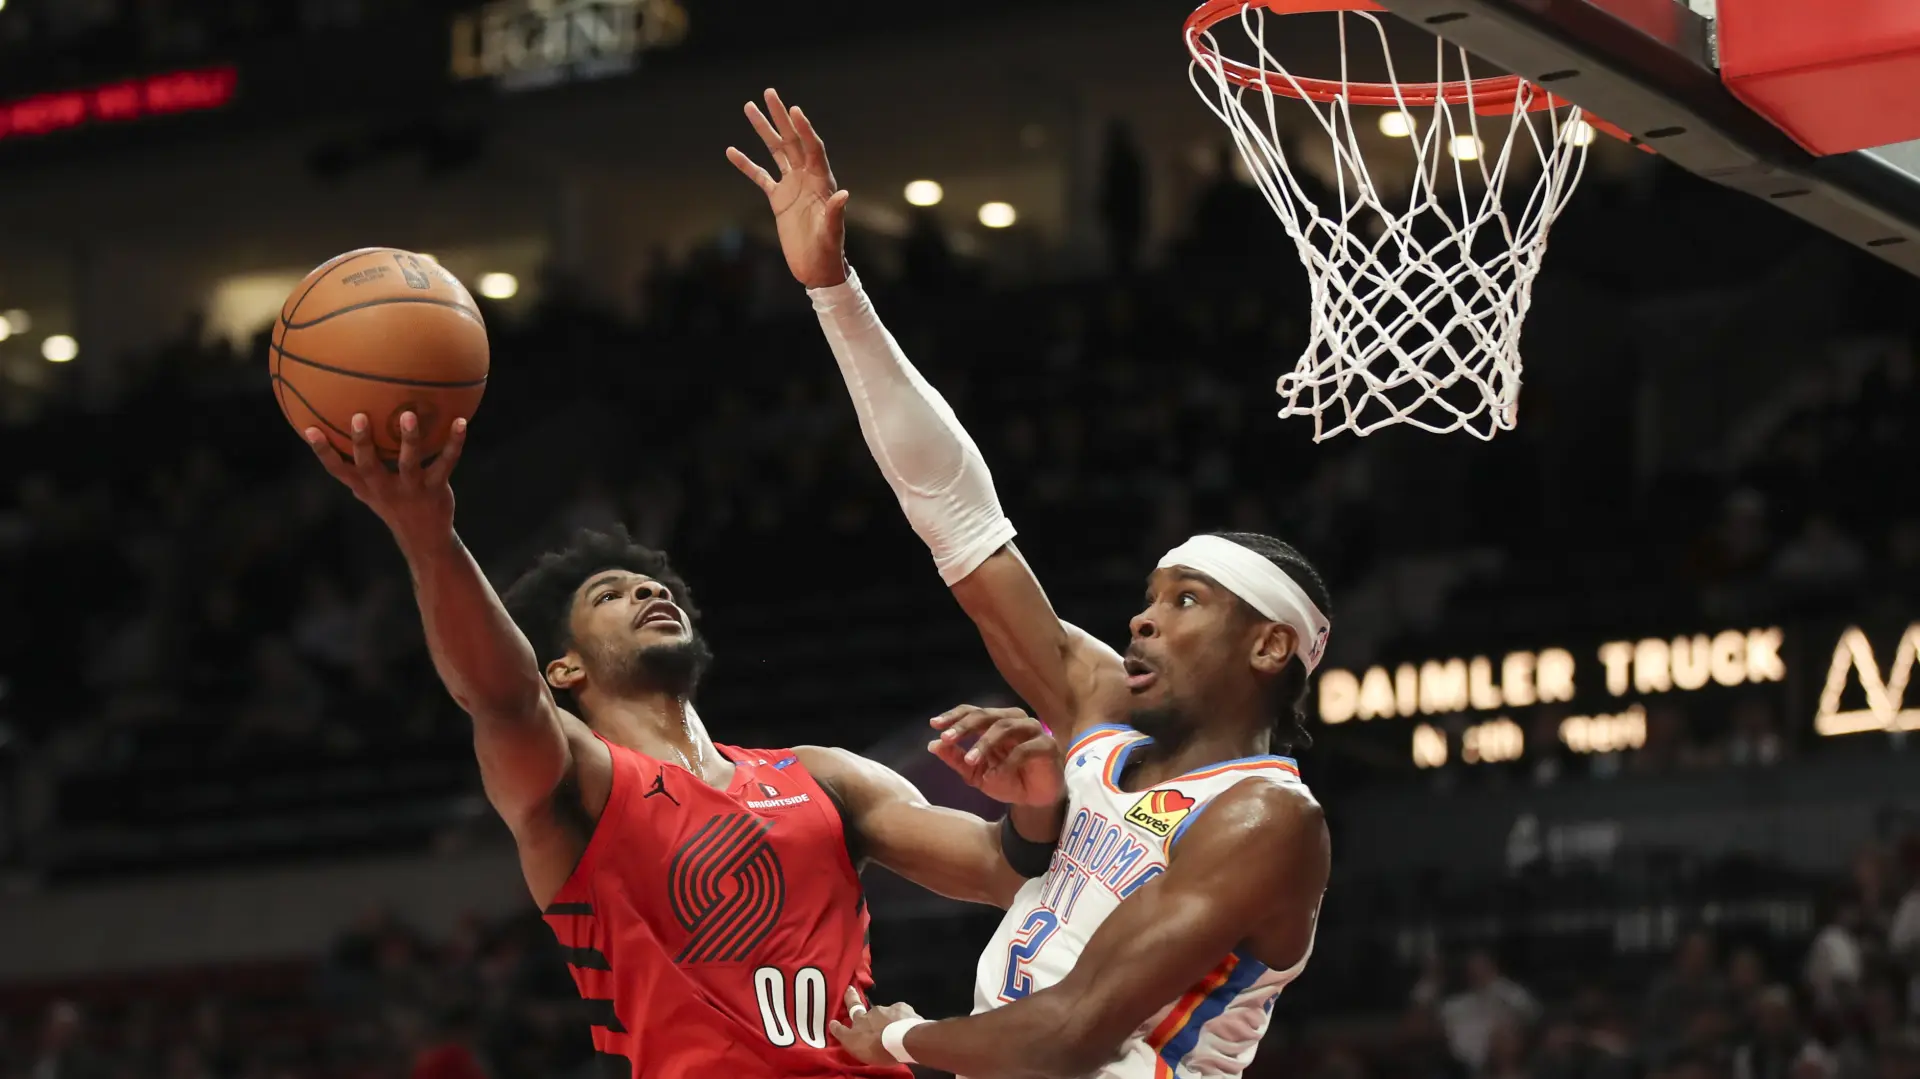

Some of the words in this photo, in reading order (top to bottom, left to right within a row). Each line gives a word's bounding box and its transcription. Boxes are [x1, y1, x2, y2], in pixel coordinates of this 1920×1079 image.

[1319, 647, 1575, 724] DAIMLER
[1598, 626, 1786, 697] TRUCK
[746, 793, 811, 809] BRIGHTSIDE
[997, 907, 1061, 1001] 2
[754, 965, 828, 1049] 00
